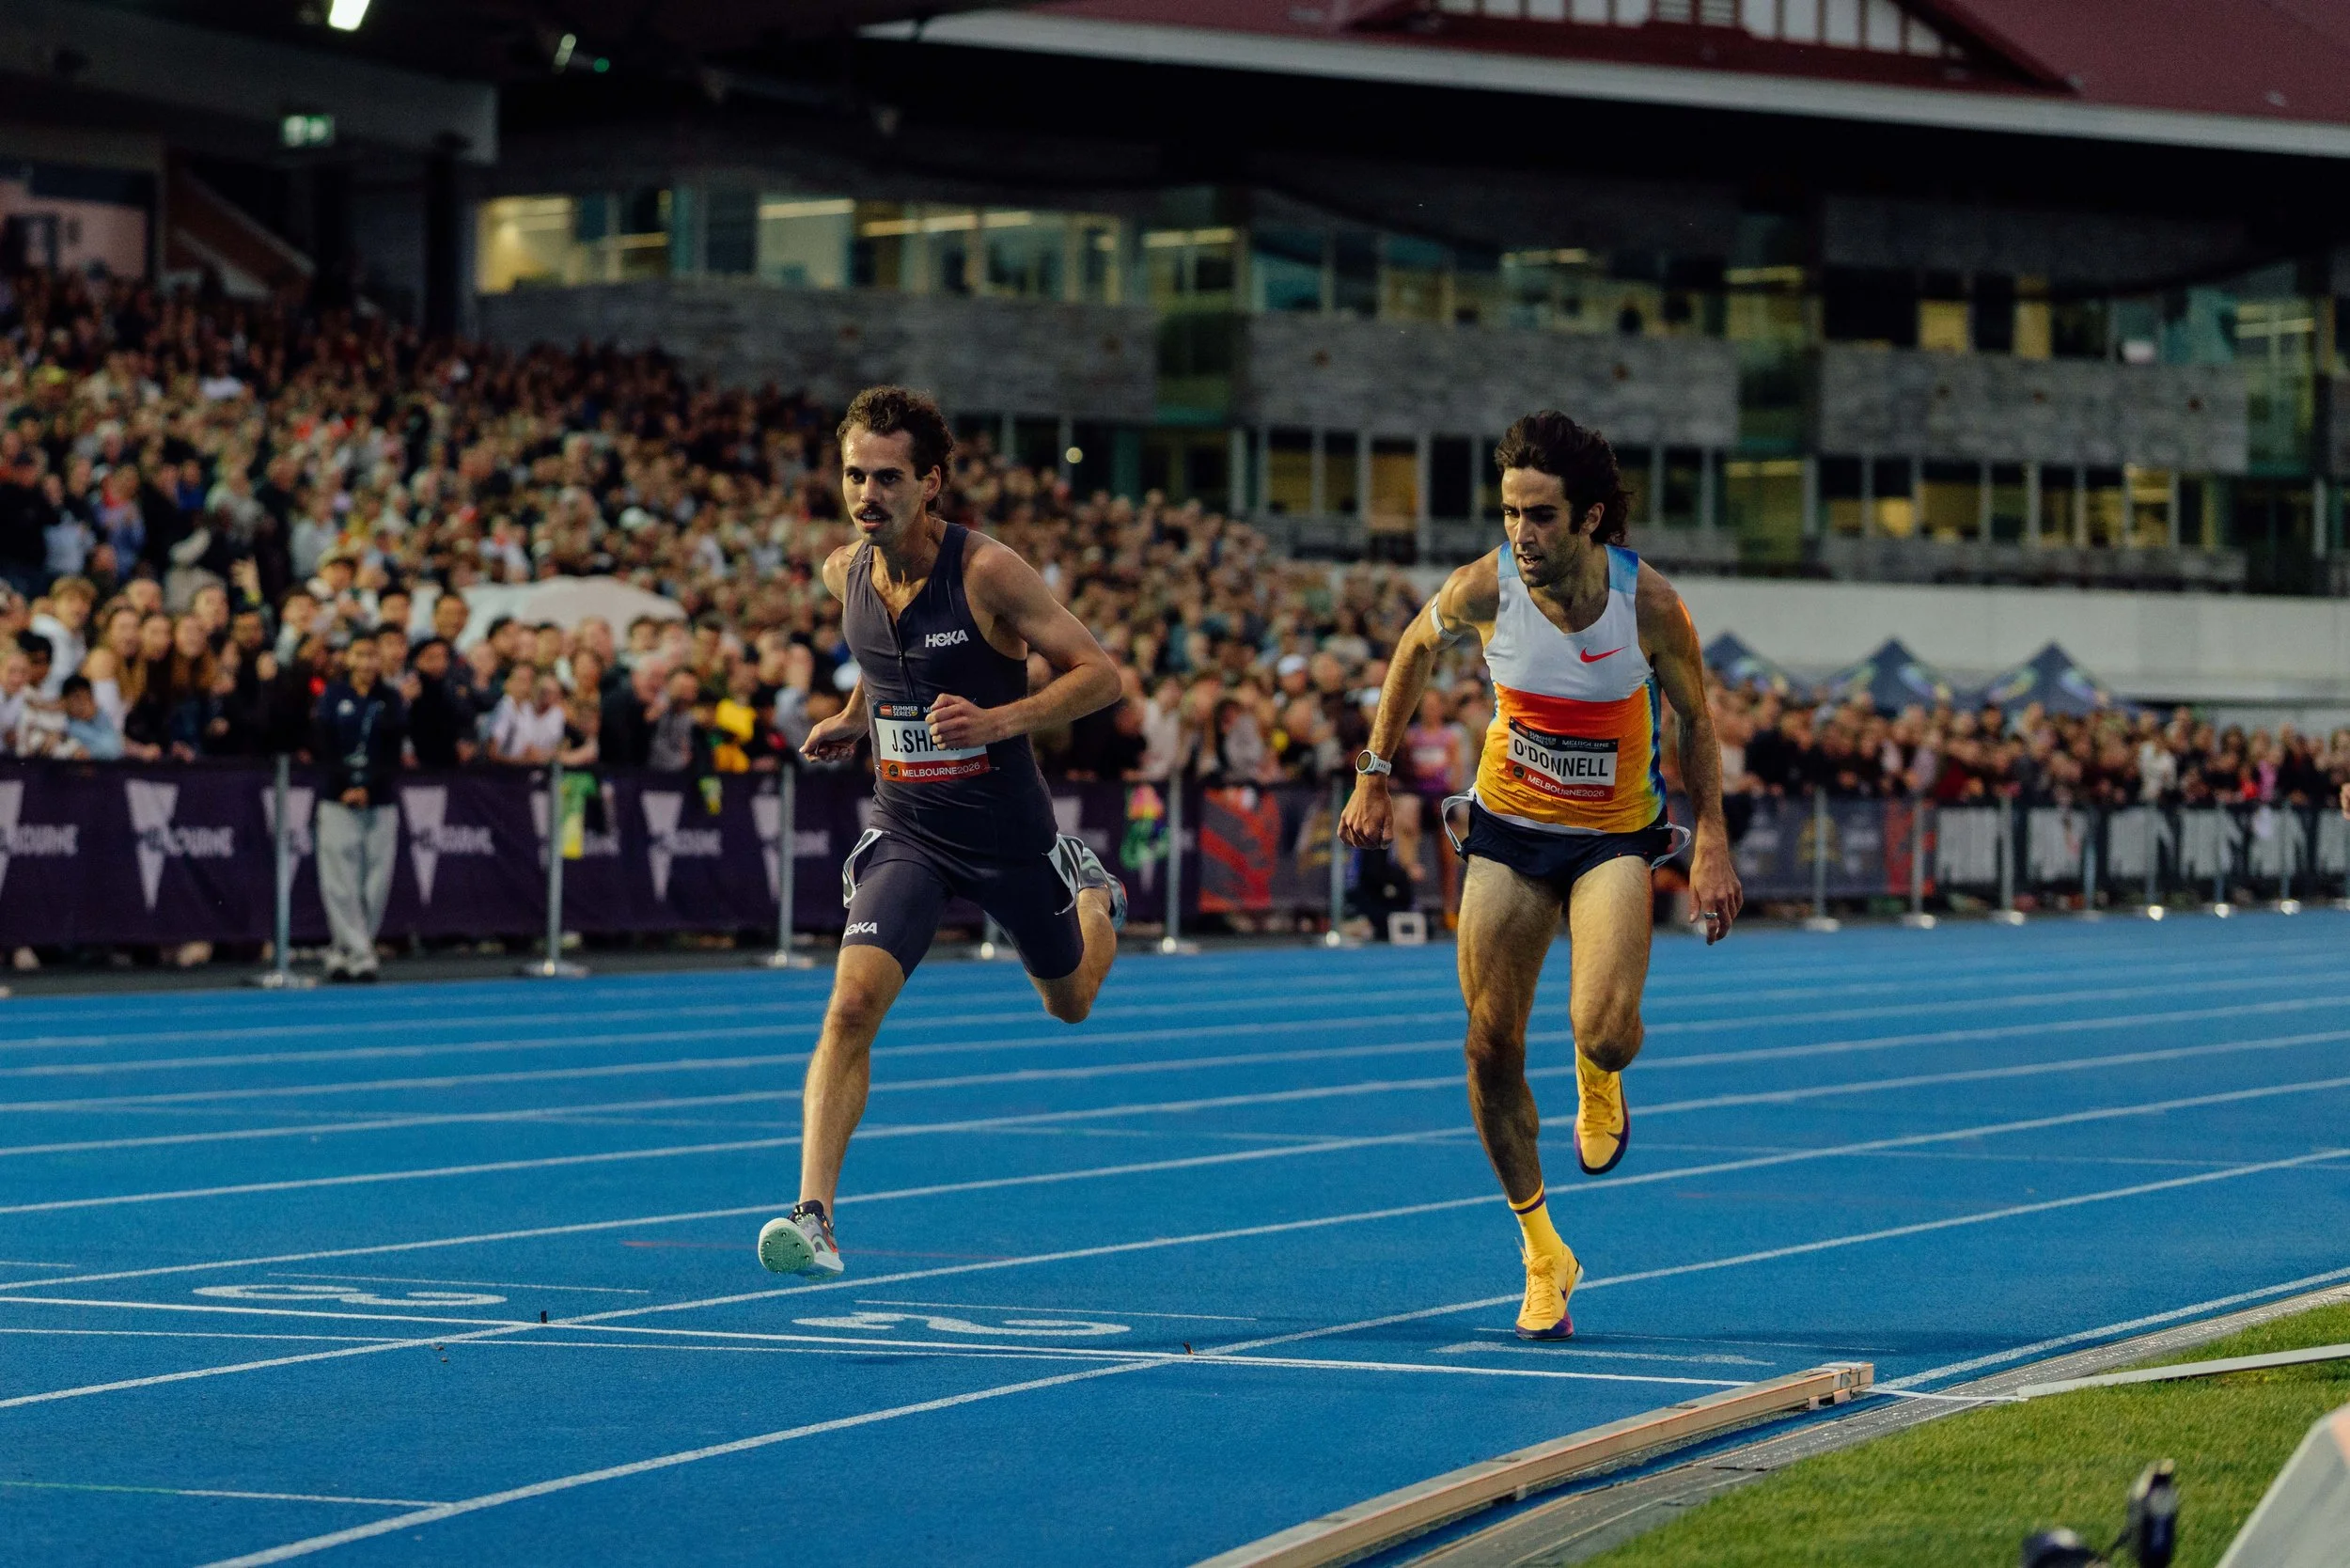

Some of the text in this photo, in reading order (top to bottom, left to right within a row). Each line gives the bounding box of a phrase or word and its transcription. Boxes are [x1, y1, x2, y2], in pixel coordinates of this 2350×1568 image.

[925, 629, 969, 648] HOKA
[892, 729, 961, 753] J.SH
[1514, 739, 1608, 777] O'DONNELL
[901, 762, 980, 777] MELBOURNE2026
[1527, 775, 1605, 797] MELBOURNE2026
